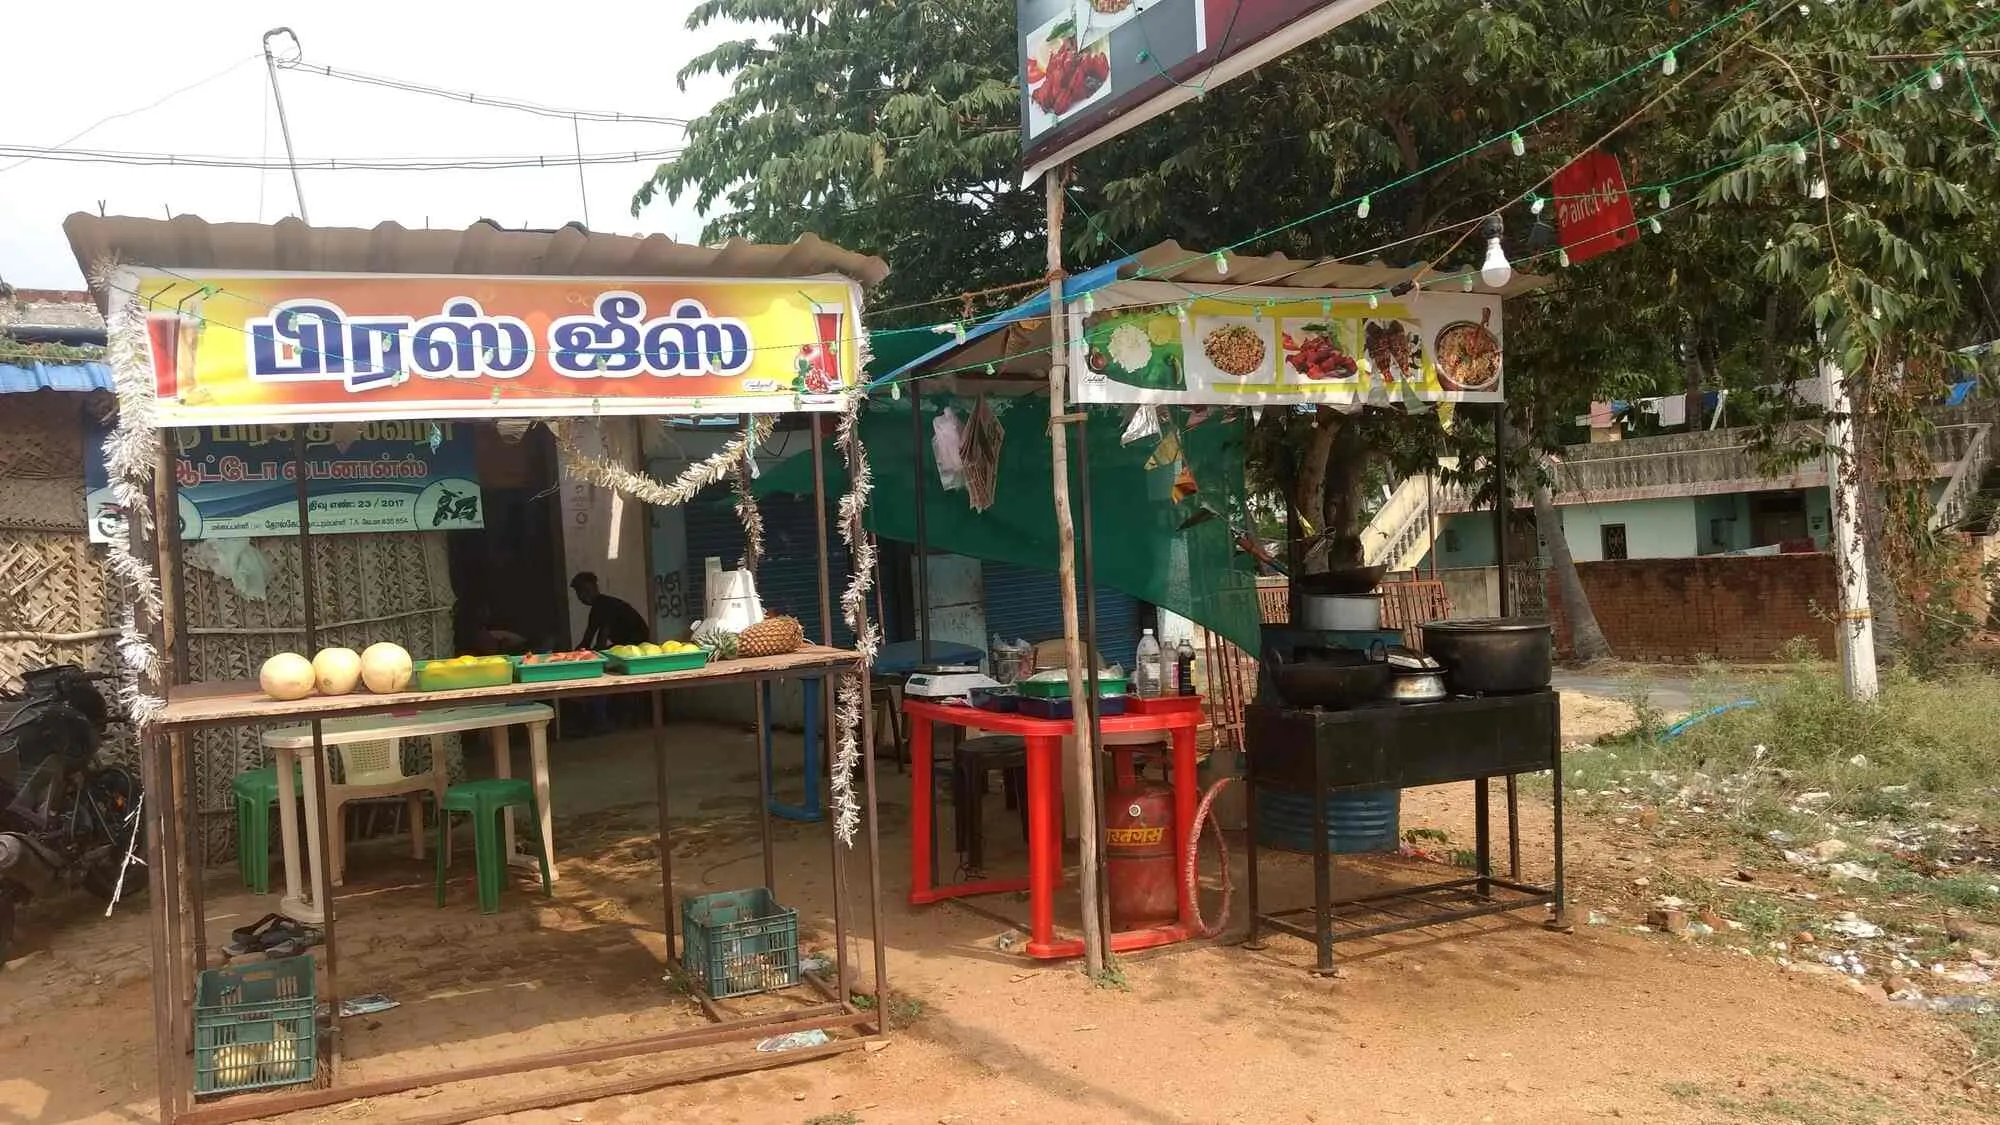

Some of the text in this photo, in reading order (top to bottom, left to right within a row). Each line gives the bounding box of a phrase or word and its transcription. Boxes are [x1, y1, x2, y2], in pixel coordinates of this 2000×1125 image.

[248, 292, 751, 390] பிரஸ் ஜீஸ்
[381, 499, 404, 508] 2017
